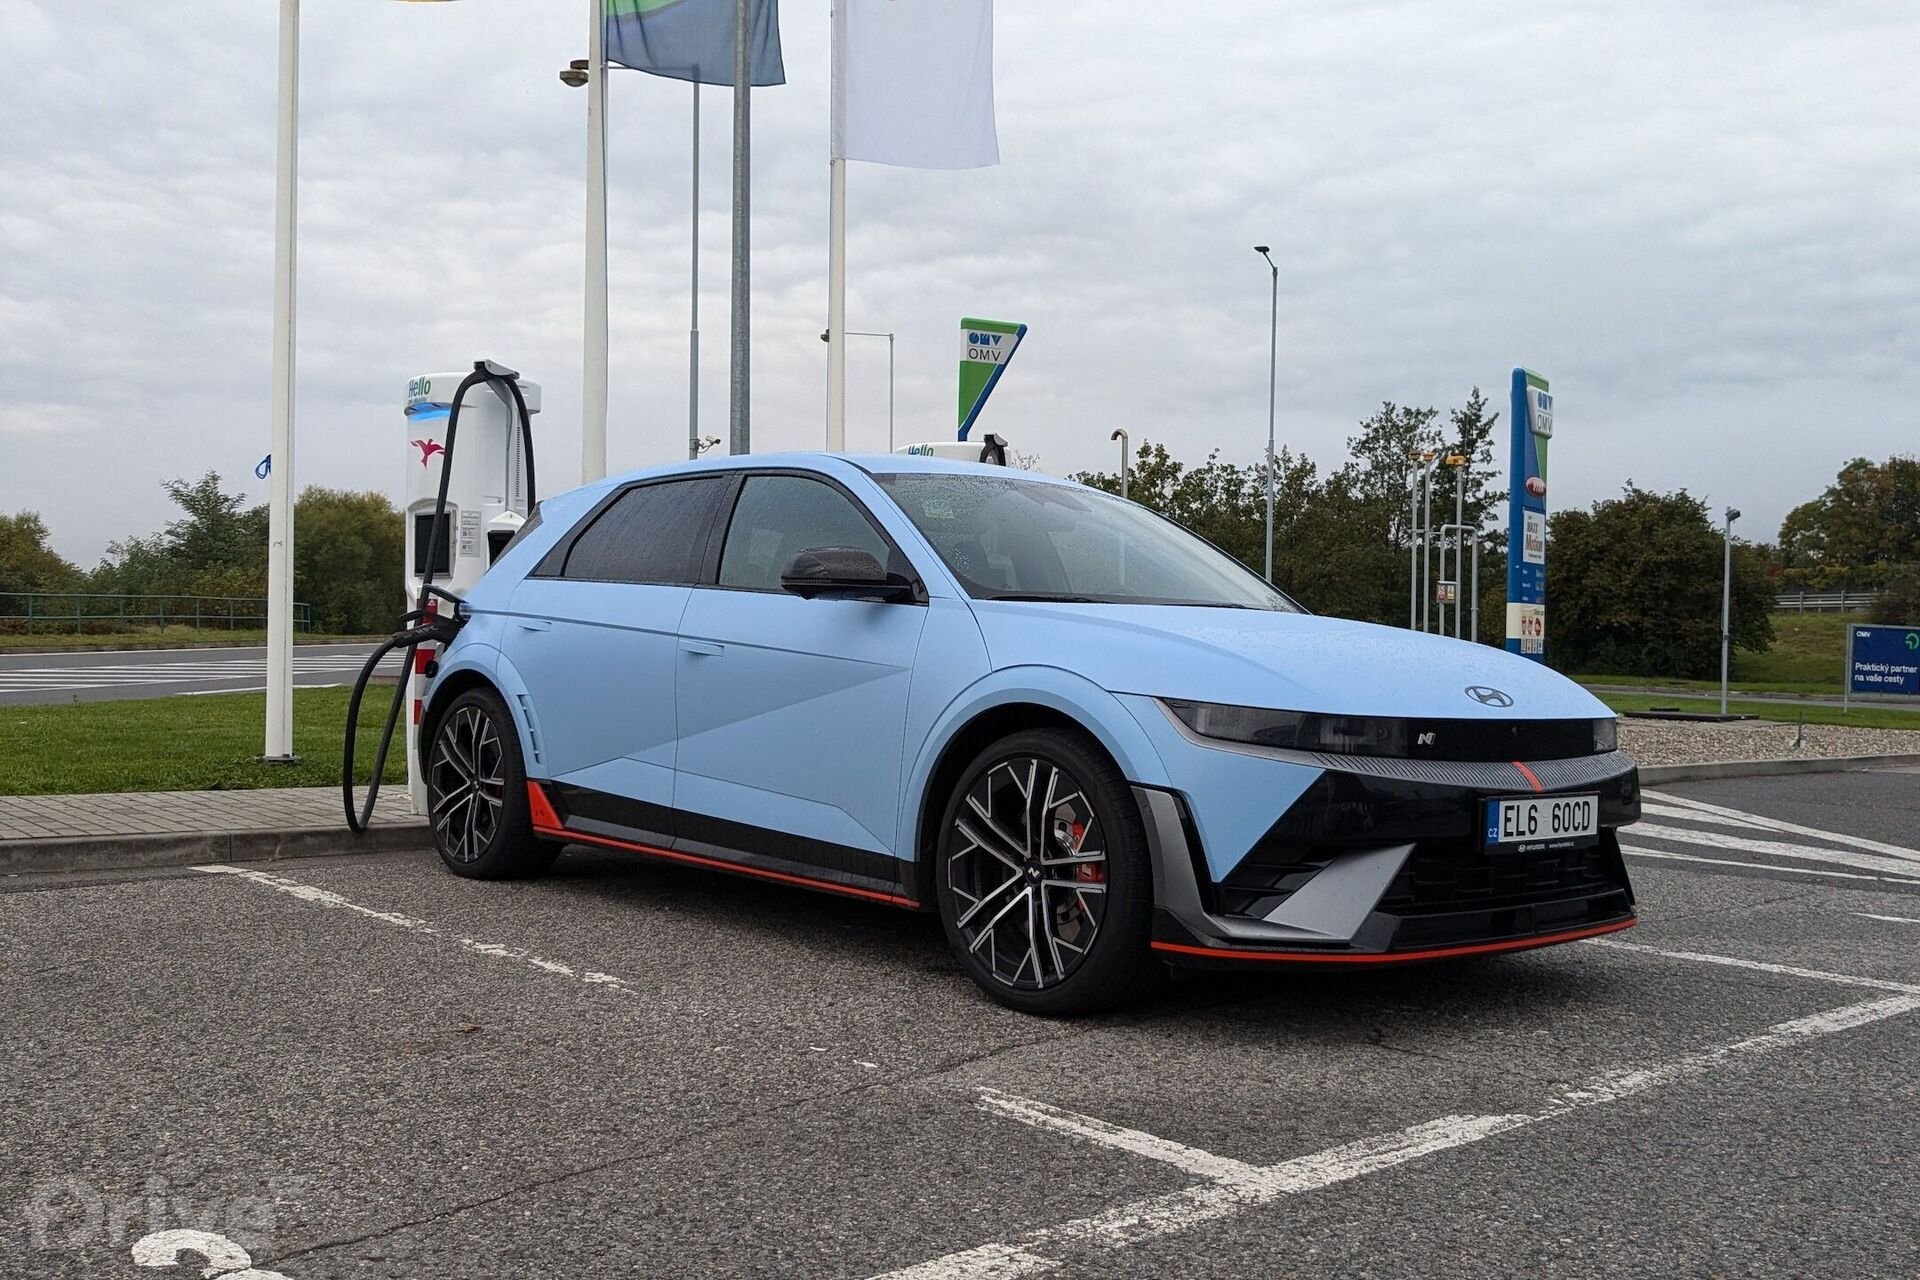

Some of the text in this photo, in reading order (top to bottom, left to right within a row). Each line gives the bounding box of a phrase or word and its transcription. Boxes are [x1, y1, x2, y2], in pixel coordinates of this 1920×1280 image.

[968, 347, 1001, 361] OMV
[408, 376, 431, 398] Hello
[1537, 414, 1552, 433] OMV
[1856, 630, 1871, 638] OMV
[1855, 662, 1918, 674] Praktický partner
[1854, 674, 1904, 685] na vaše cesty
[1503, 800, 1591, 838] EL6 60CD
[1487, 827, 1499, 838] CZ
